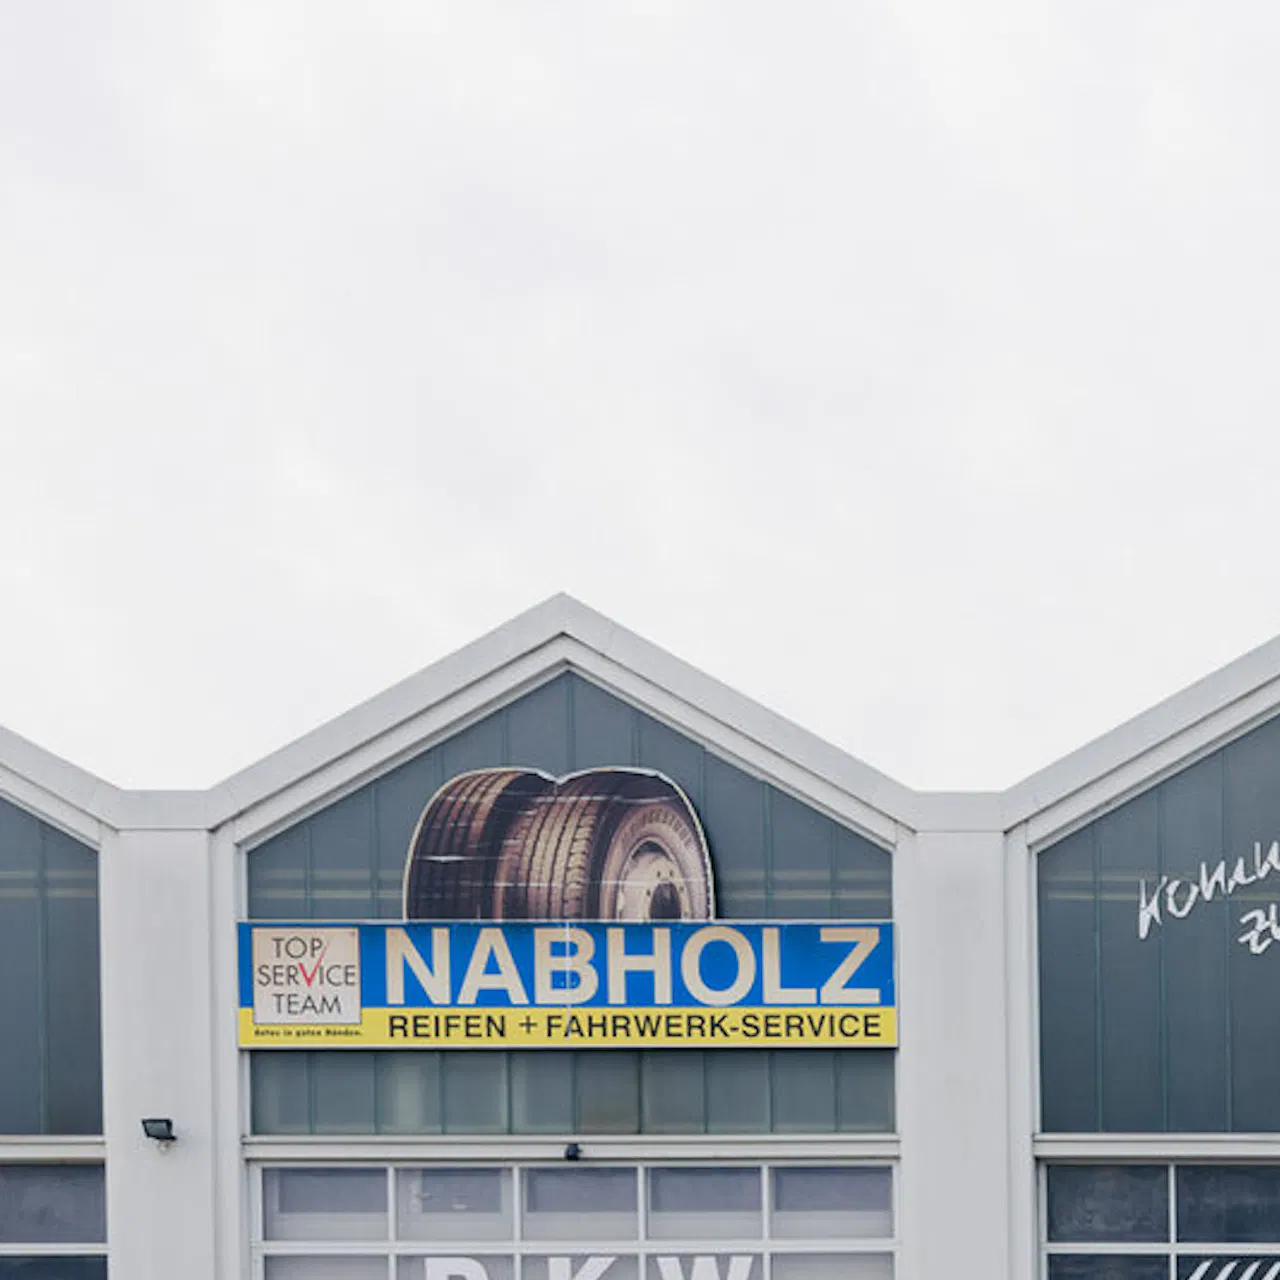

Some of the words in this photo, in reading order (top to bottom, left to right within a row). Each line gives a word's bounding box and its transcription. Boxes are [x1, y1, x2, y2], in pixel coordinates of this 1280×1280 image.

[272, 937, 323, 959] TOP
[257, 963, 356, 987] SERVICE
[385, 926, 881, 1006] NABHOLZ
[273, 994, 341, 1014] TEAM
[388, 1015, 506, 1037] REIFEN
[519, 1017, 537, 1035] +
[547, 1014, 881, 1037] FAHRWERK-SERVICE
